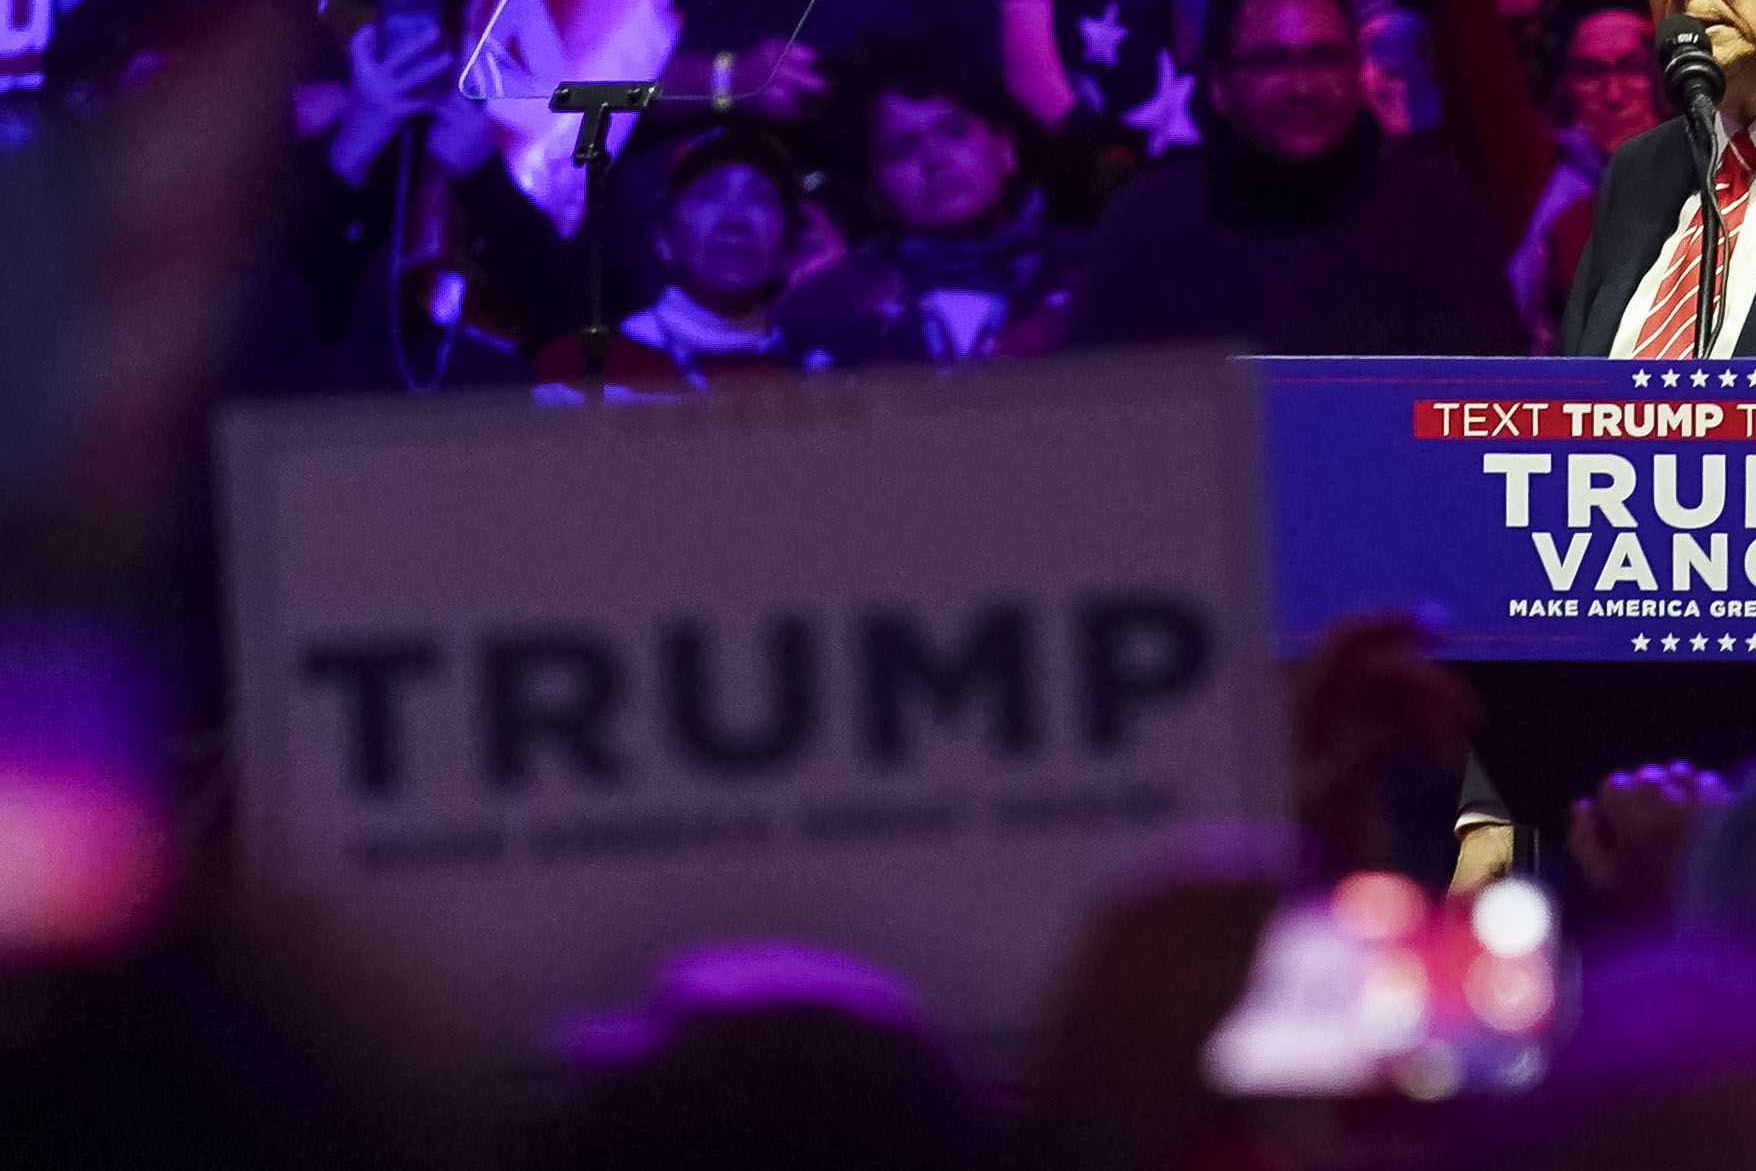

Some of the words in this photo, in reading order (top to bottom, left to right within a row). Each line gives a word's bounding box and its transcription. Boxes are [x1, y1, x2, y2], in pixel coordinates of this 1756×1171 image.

[1433, 402, 1549, 437] TEXT
[1562, 403, 1724, 438] TRUMP
[1509, 599, 1579, 617] MAKE
[1587, 599, 1701, 618] AMERICA
[300, 586, 1212, 795] TRUMP
